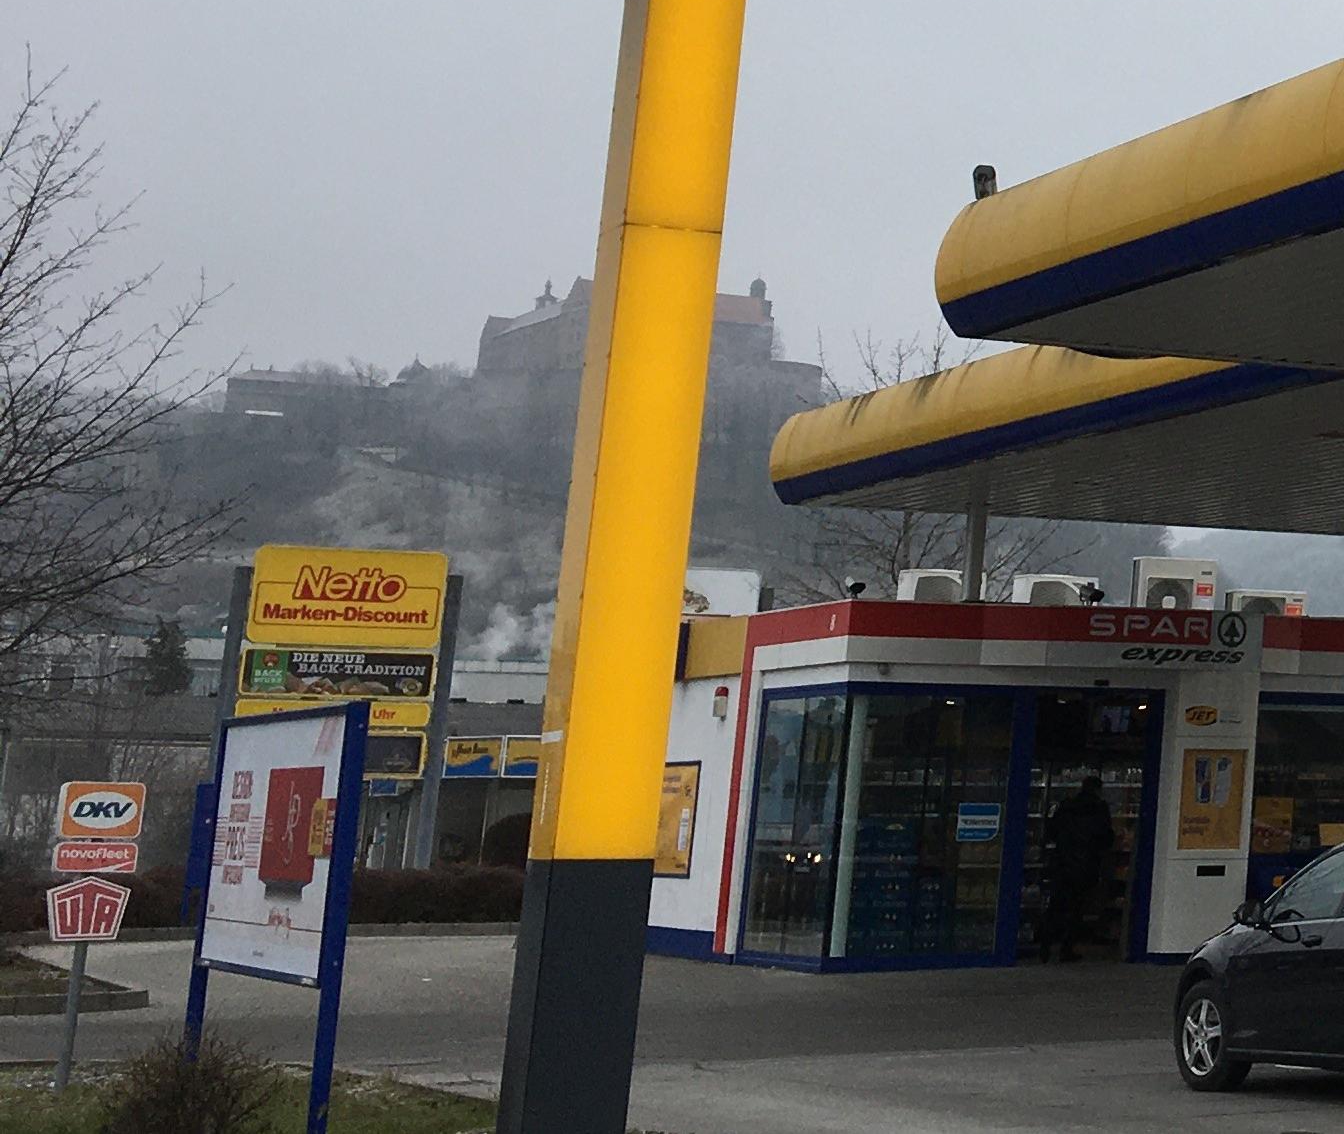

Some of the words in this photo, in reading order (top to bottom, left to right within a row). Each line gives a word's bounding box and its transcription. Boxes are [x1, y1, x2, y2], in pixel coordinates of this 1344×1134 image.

[292, 565, 408, 603] Netto
[263, 602, 428, 624] Marken-Discount
[1089, 614, 1208, 640] SPAR
[292, 652, 319, 663] DIE
[323, 654, 365, 664] NEUE
[1121, 647, 1244, 665] express
[297, 663, 426, 676] BACK-TRADITION
[373, 709, 396, 721] Uhr
[1190, 709, 1212, 722] JET
[72, 801, 133, 818] DKV
[61, 847, 130, 859] novofleet
[57, 886, 122, 936] UTA
